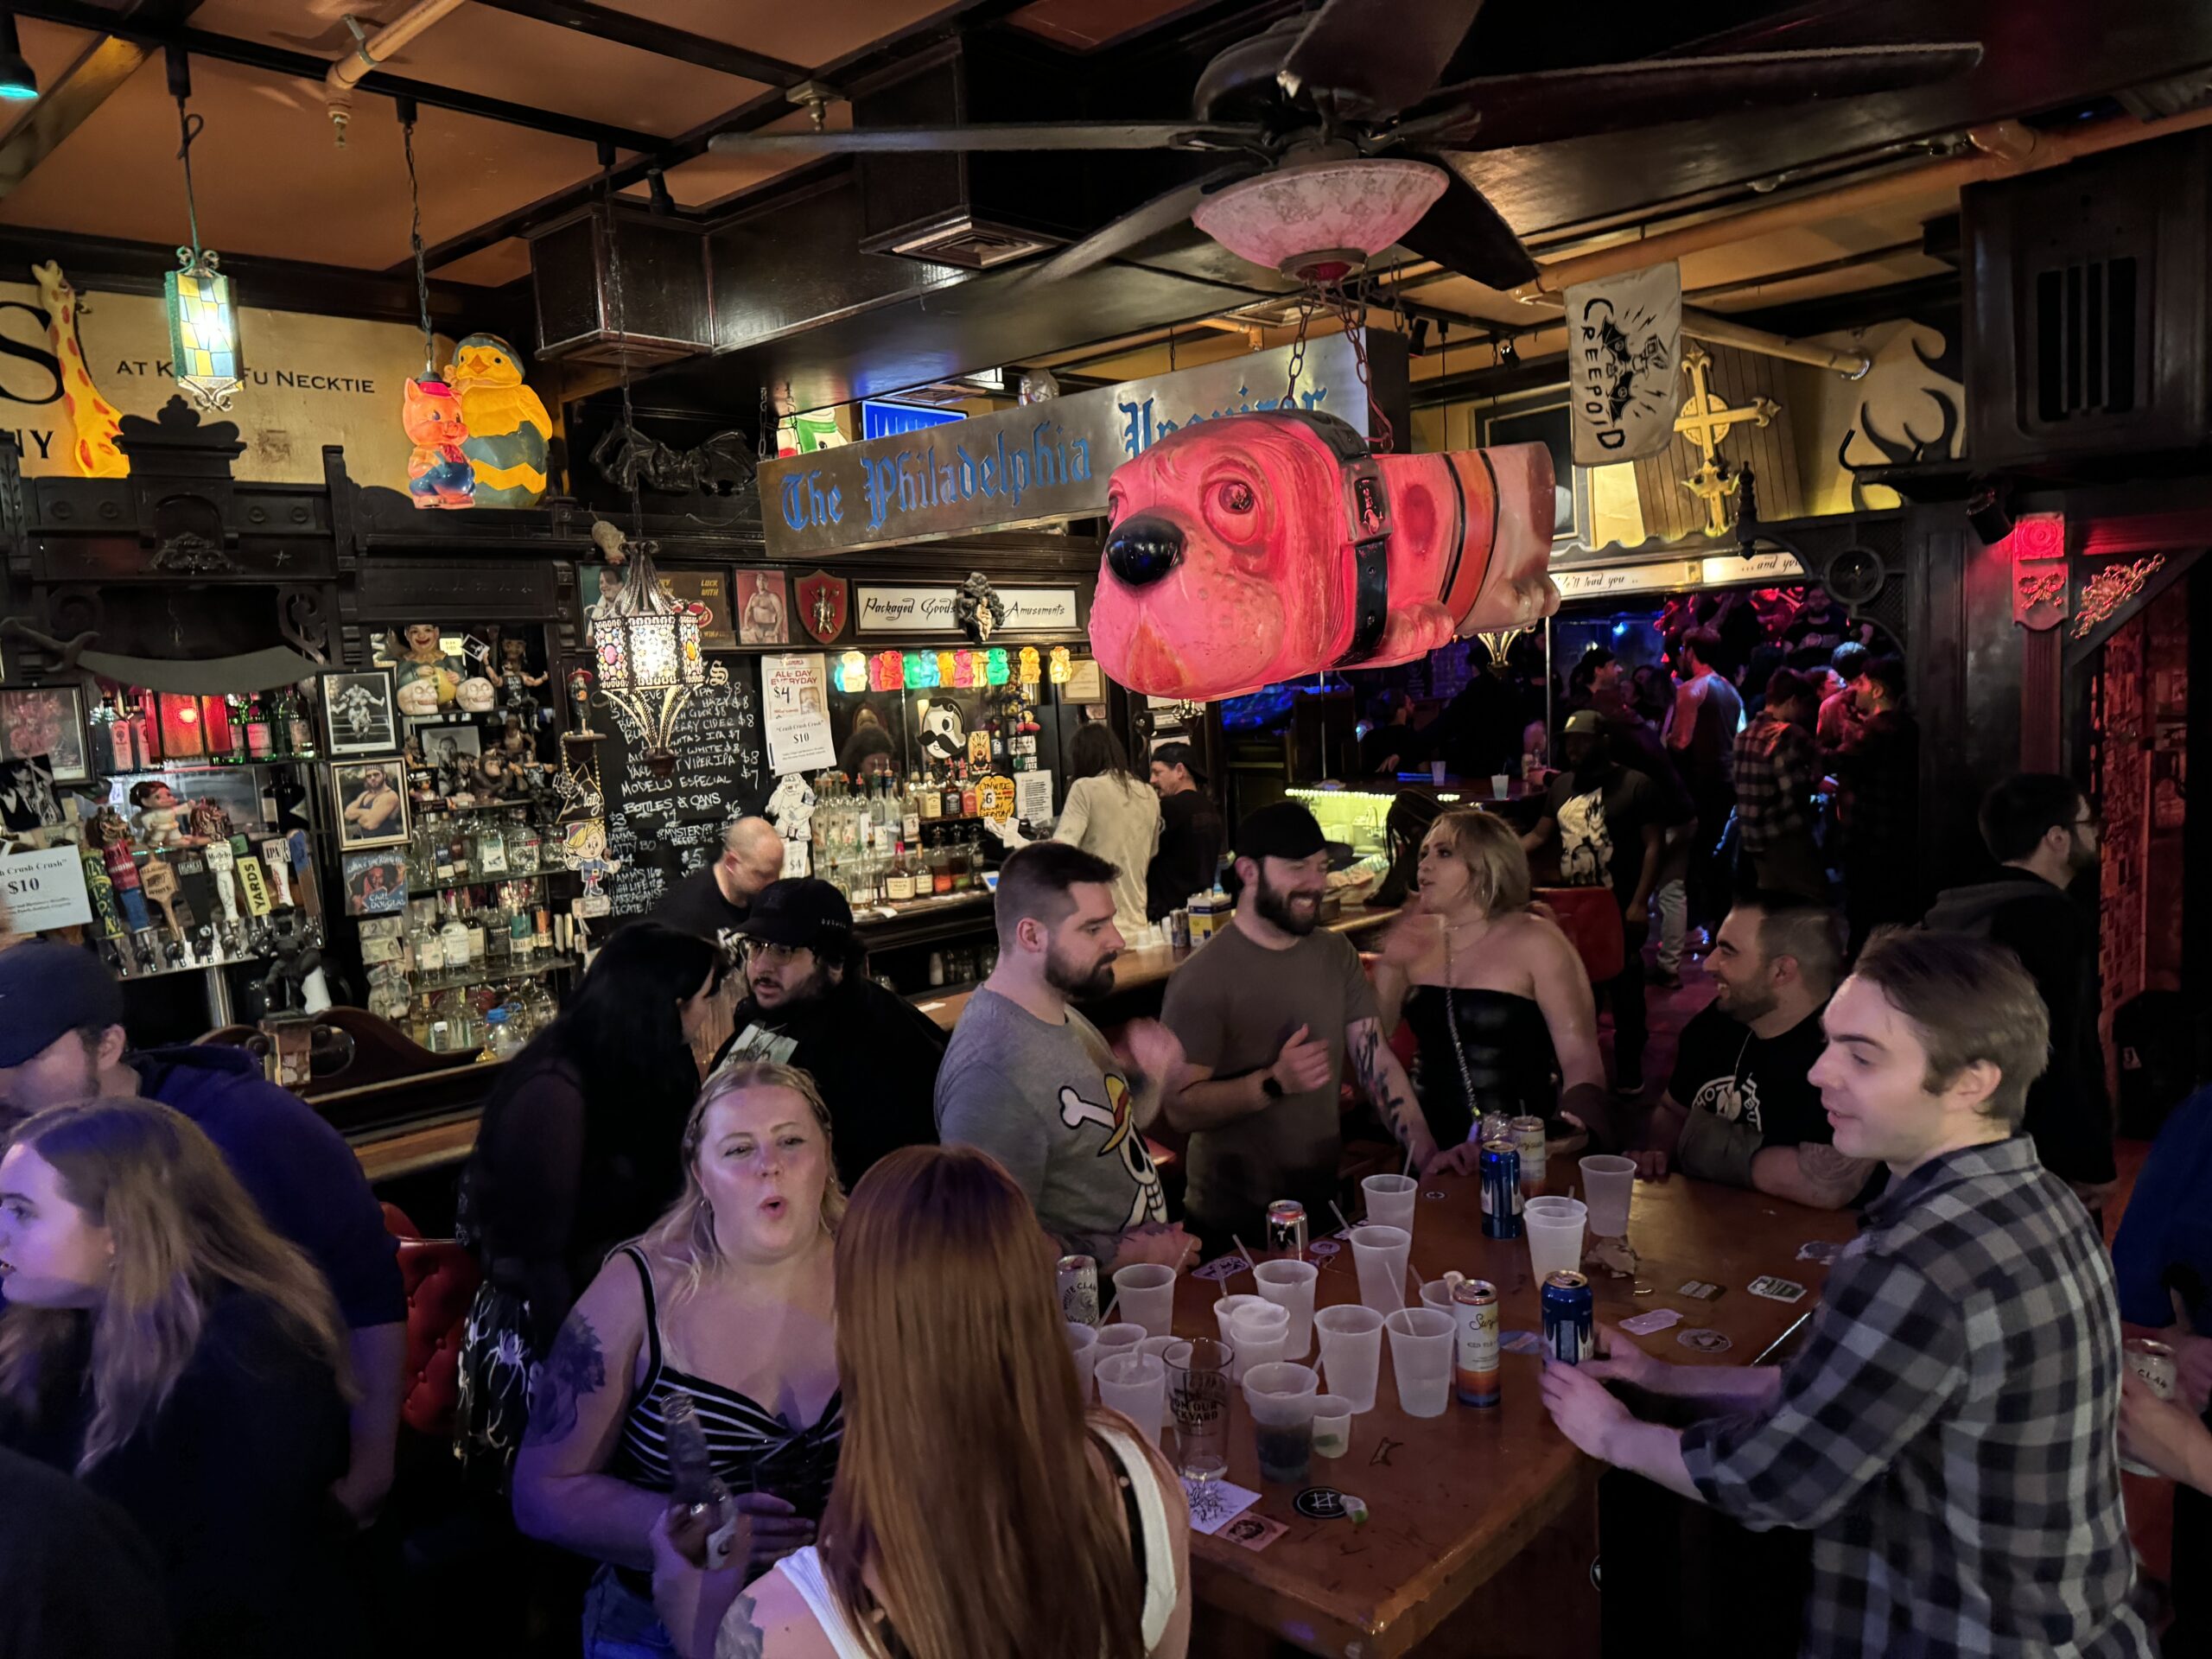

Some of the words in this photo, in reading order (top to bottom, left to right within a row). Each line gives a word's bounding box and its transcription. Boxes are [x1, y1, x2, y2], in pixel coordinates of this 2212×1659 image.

[116, 360, 148, 375] AT
[276, 371, 375, 393] NECKTIE
[1581, 297, 1626, 450] CREEPOID
[781, 470, 844, 532] The
[860, 420, 1092, 532] Philadelphia
[1607, 575, 1624, 590] you
[861, 597, 915, 620] Packaged
[920, 597, 957, 620] Goods
[1004, 601, 1065, 618] Amusements
[773, 686, 791, 704] $4
[702, 717, 734, 729] CIDER
[738, 711, 754, 728] $8
[705, 731, 726, 741] IPA
[728, 729, 741, 741] $7
[793, 732, 810, 744] $10
[687, 744, 723, 754] WHITE
[741, 747, 760, 765] $8
[621, 779, 673, 798] MODELO
[679, 774, 733, 788] ESPECIAL
[741, 764, 759, 791] $7
[622, 798, 673, 814] BOTTLES
[690, 791, 721, 807] CANS
[265, 846, 281, 860] IPA
[7, 865, 34, 875] Crush
[8, 877, 40, 895] $10
[245, 862, 266, 910] YARDS
[370, 897, 406, 910] DOUGLAS
[1193, 1402, 1217, 1411] OUR
